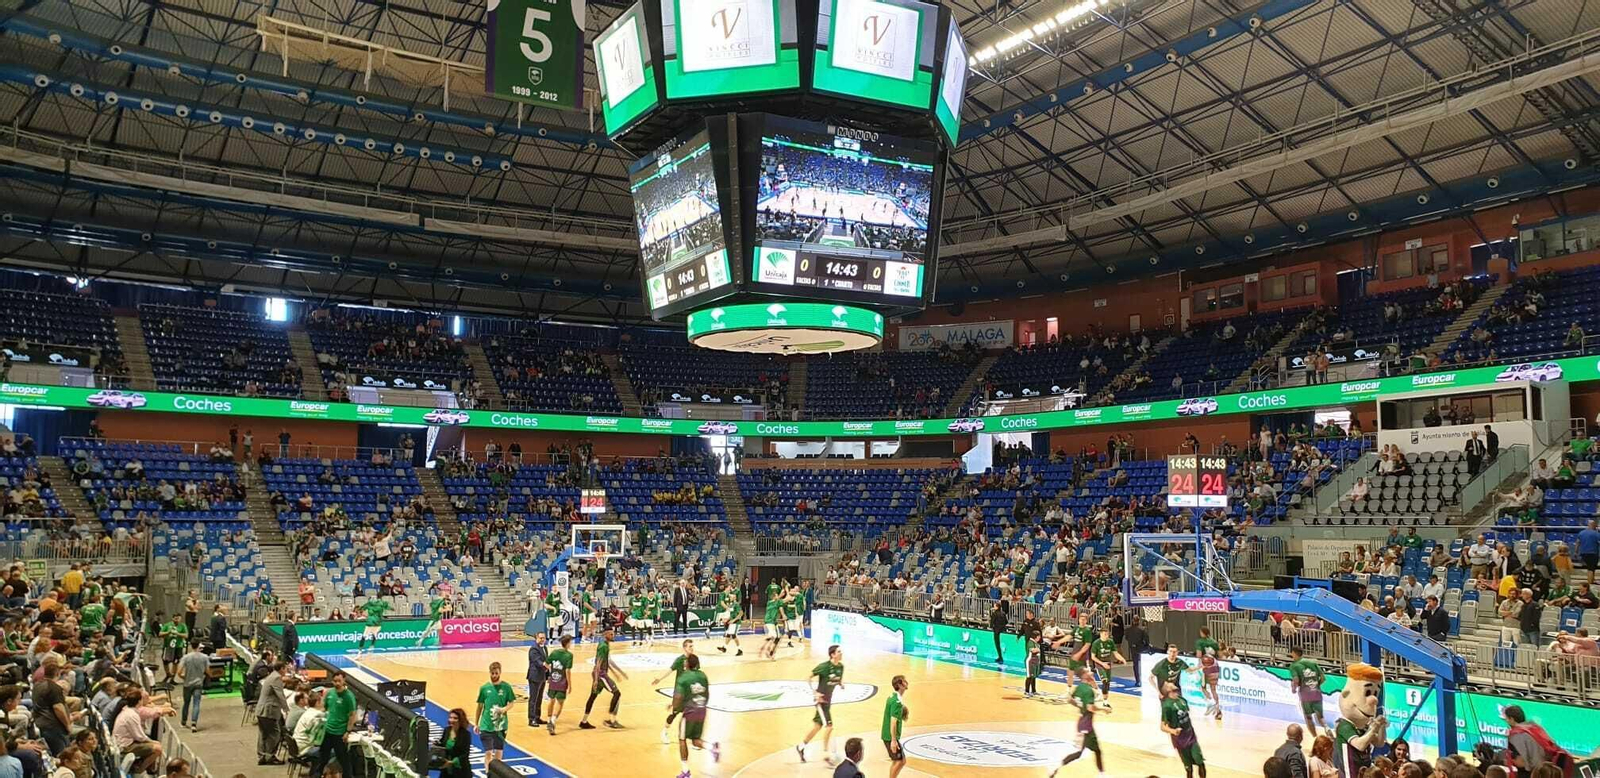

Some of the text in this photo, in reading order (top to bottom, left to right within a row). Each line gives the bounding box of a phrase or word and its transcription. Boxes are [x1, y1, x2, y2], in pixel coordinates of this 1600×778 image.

[711, 7, 742, 39] V
[520, 7, 553, 63] 5
[512, 86, 531, 97] 1999
[539, 90, 558, 101] 2012
[837, 126, 879, 142] MONDO
[800, 259, 808, 271] 0
[825, 261, 858, 277] 14:43
[765, 269, 788, 279] Unicaja
[872, 267, 881, 279] 0
[1412, 373, 1457, 386] Europcar
[1, 383, 48, 396] Europcar
[1341, 380, 1381, 393] Europcar
[173, 396, 231, 412] Coches
[290, 400, 329, 411] Europcar
[1238, 394, 1287, 409] Coches
[357, 405, 394, 415] Europcar
[1074, 408, 1102, 418] Europcar
[1122, 404, 1152, 414] Europcar
[491, 413, 538, 427] Coches
[586, 415, 618, 426] Europcar
[641, 418, 673, 428] Europcar
[843, 421, 874, 430] Europcar
[895, 420, 924, 430] Europcar
[1001, 416, 1037, 429] Coches
[756, 423, 799, 434] Coches
[1170, 458, 1197, 469] 14:43
[1200, 458, 1226, 469] 14:43
[1171, 474, 1194, 494] 24
[1202, 474, 1224, 494] 24
[590, 497, 603, 507] 24
[1185, 599, 1225, 610] endesa
[444, 622, 499, 634] endesa
[940, 735, 1049, 762] PEDRIZAS
